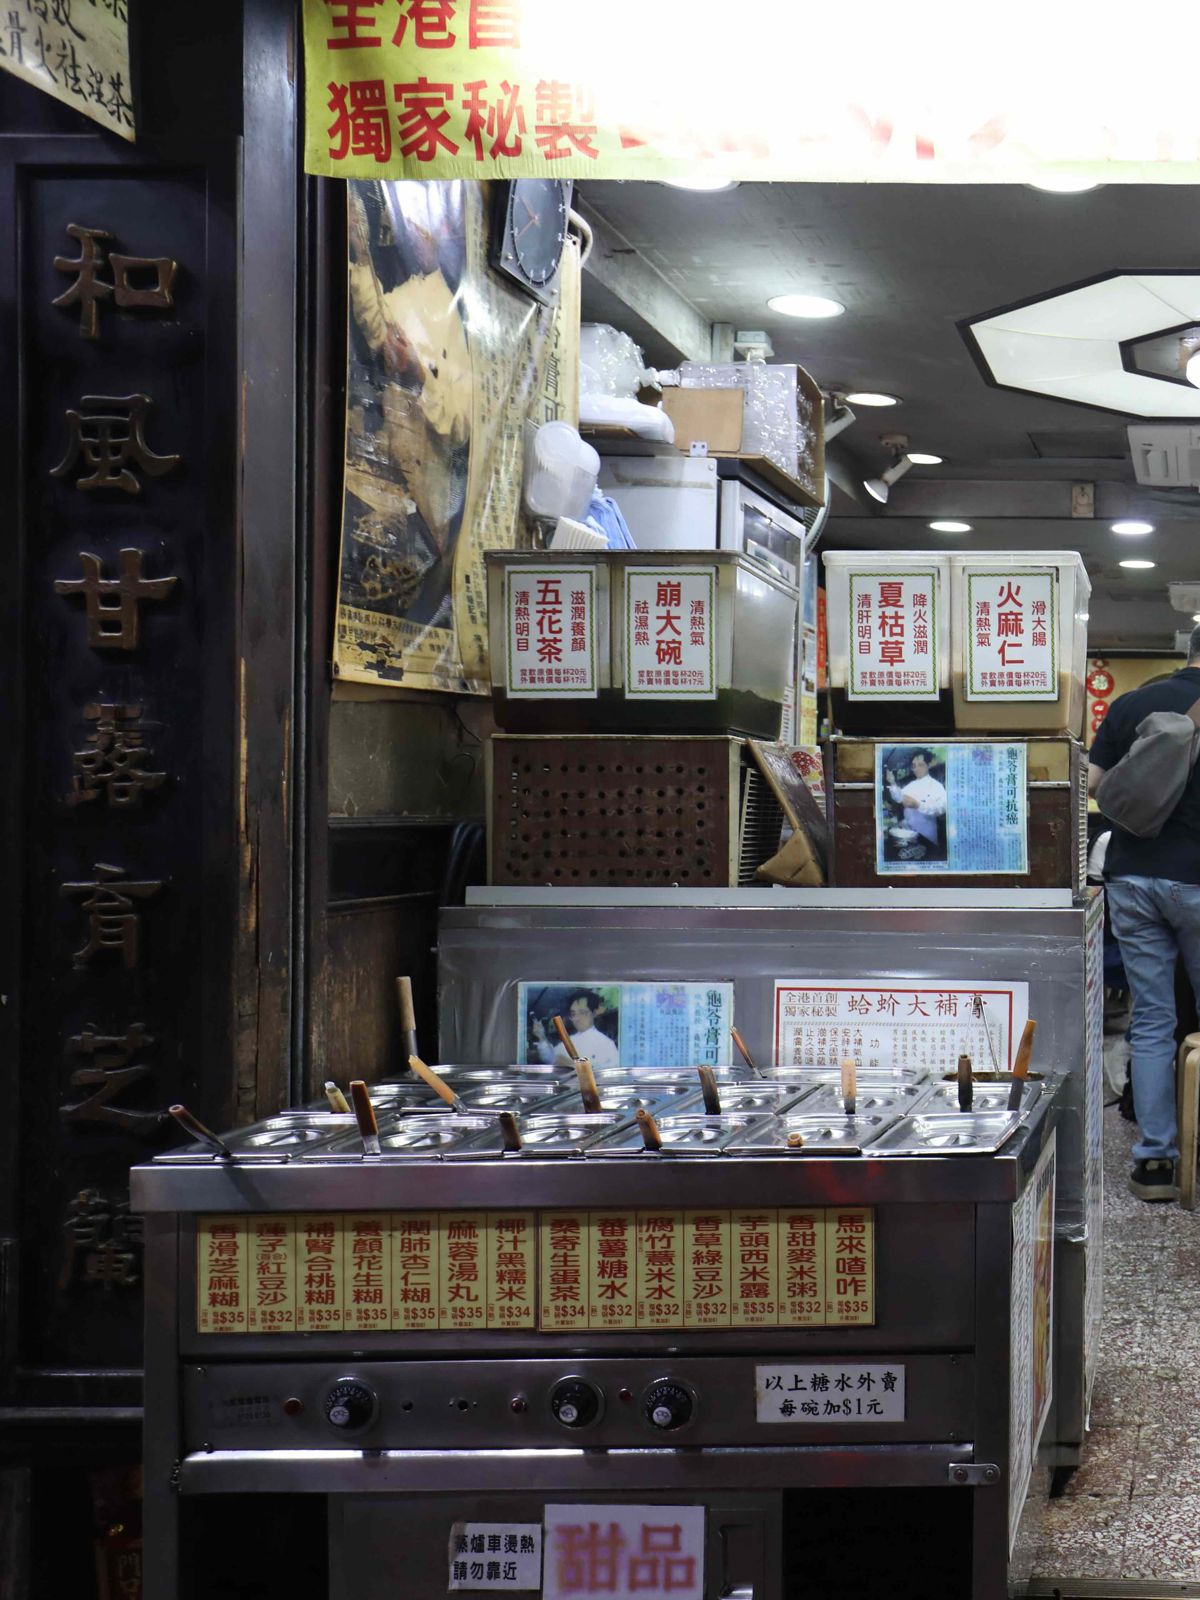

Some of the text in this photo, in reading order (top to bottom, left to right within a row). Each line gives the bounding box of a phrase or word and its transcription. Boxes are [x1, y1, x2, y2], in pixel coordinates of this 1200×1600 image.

[536, 579, 563, 664] 五花茶
[656, 580, 682, 665] 崩大碗
[878, 582, 905, 666] 夏枯草
[997, 581, 1024, 666] 火麻仁
[208, 1224, 240, 1308] 香滑芝麻糊
[352, 1221, 383, 1304] 養顏花生糊
[400, 1220, 431, 1304] 潤肺杏仁糊
[447, 1220, 479, 1302] 麻蓉湯丸
[495, 1218, 527, 1302] 椰汁黑糯米
[550, 1218, 581, 1301] 桑寄生蛋茶
[597, 1218, 628, 1300] 蕃薯糖水
[692, 1216, 724, 1300] 香草綠豆沙
[739, 1216, 770, 1299] 芋頭西米露
[786, 1215, 818, 1298] 香甜麥米粥
[764, 1371, 899, 1394] 以上糖水外賣
[778, 1398, 884, 1418] 每碗加$1元
[452, 1560, 518, 1582] 請勿靠近
[555, 1521, 697, 1593] 甜品
